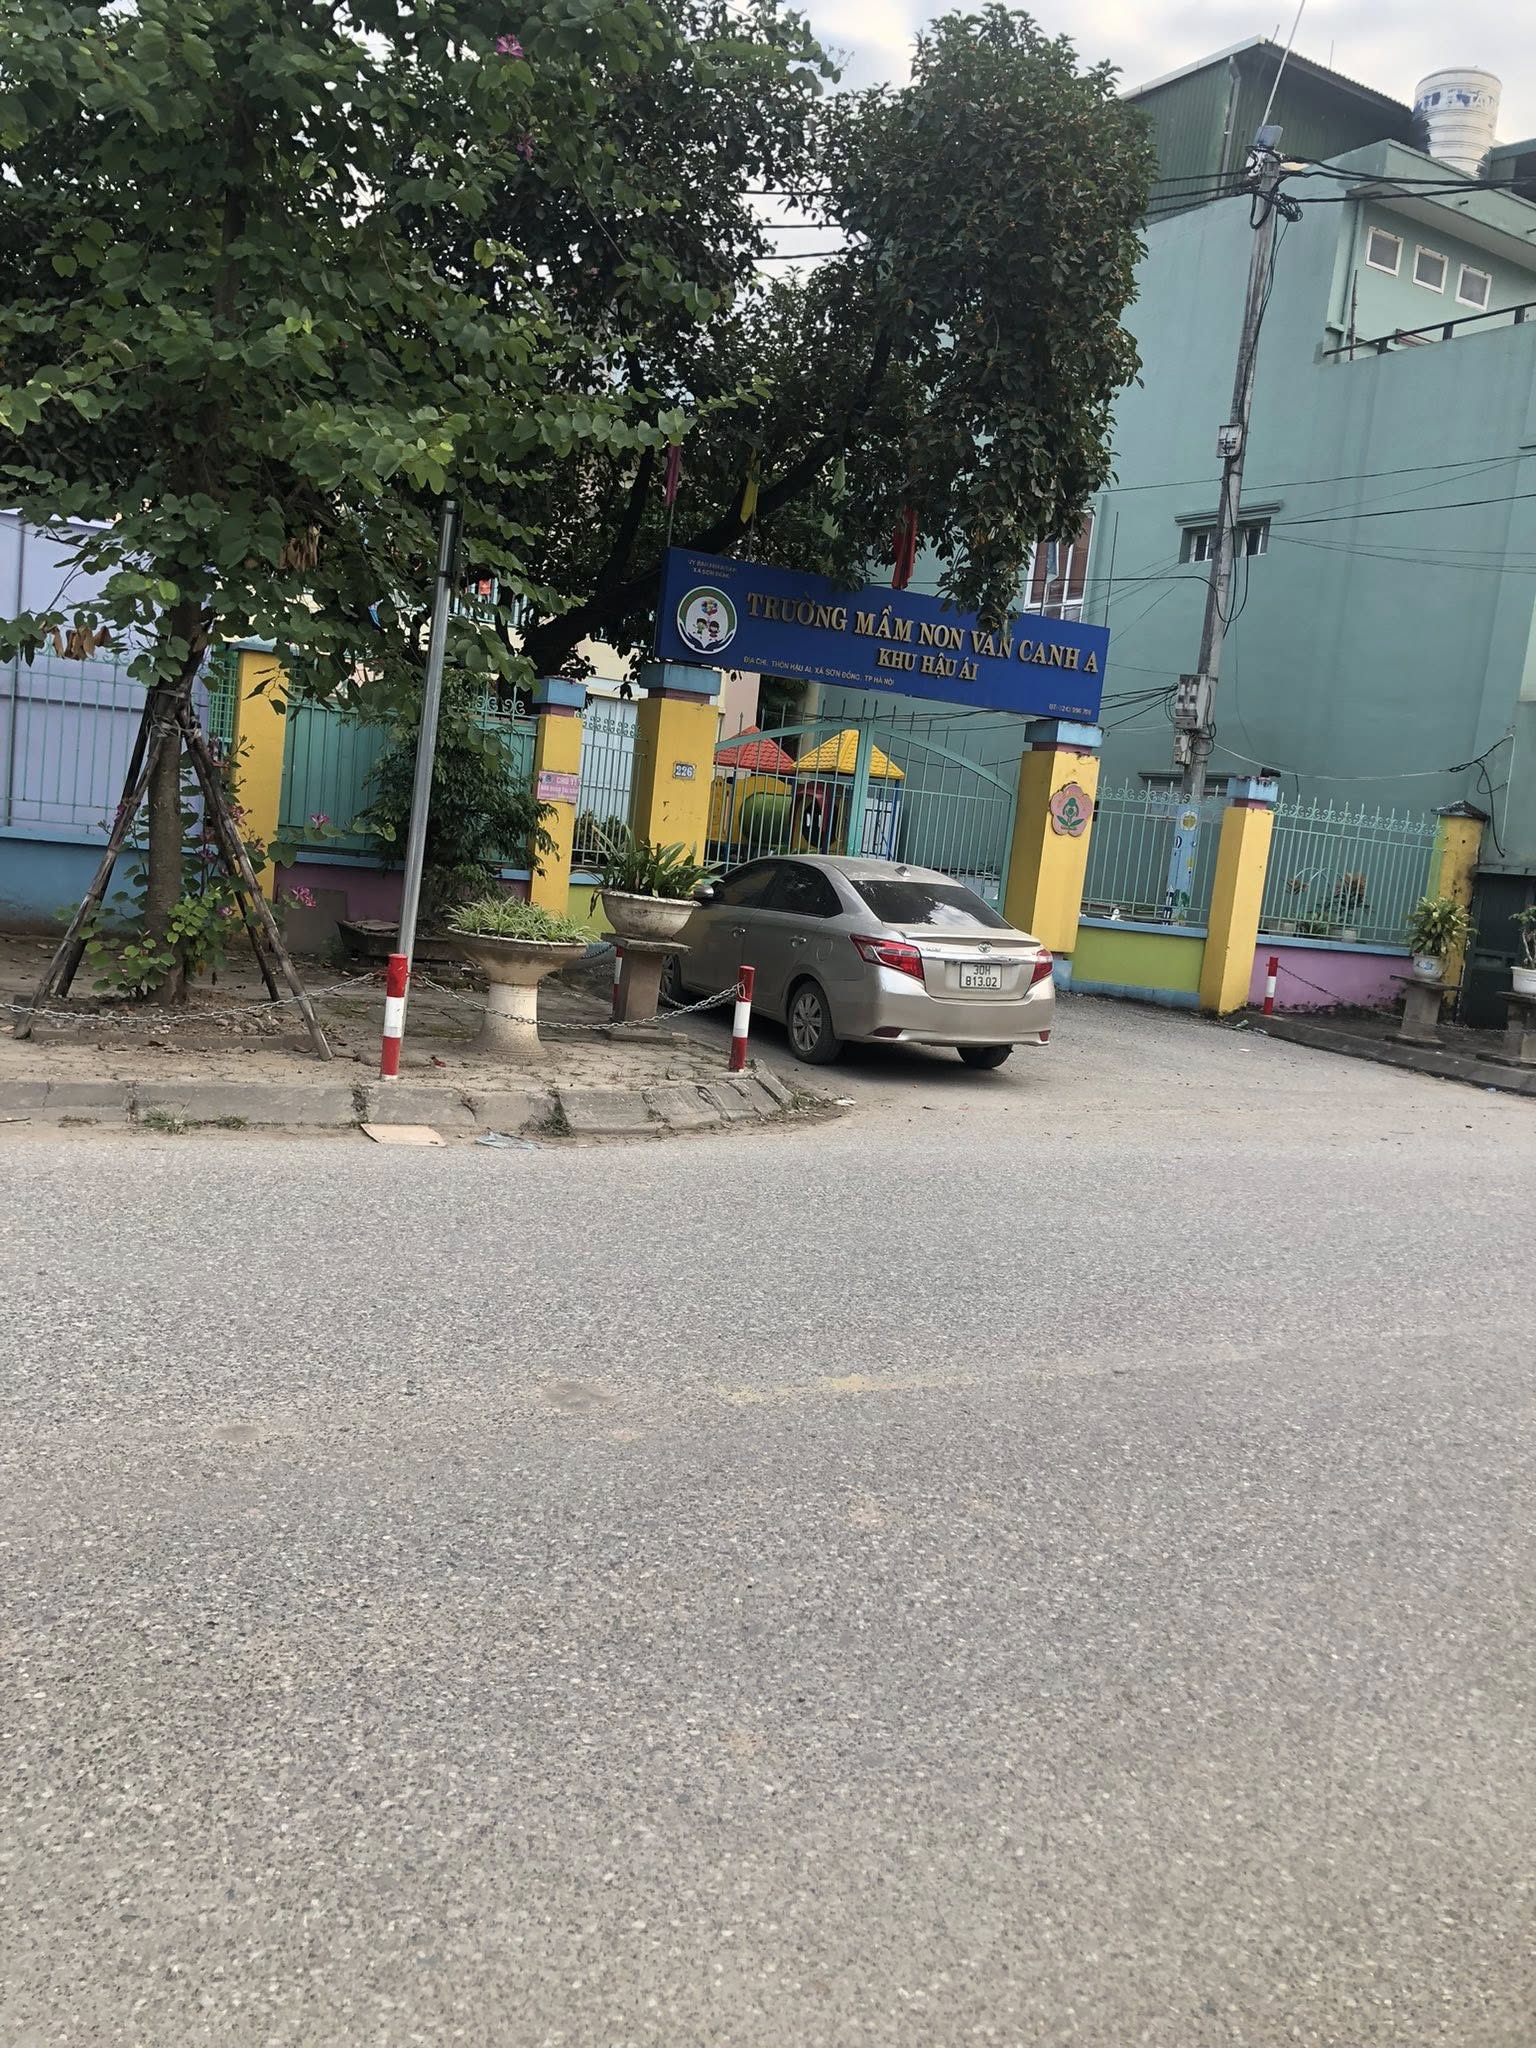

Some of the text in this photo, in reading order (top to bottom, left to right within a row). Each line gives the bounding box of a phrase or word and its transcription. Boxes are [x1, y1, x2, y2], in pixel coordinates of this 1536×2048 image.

[854, 604, 914, 643] MẦM
[918, 622, 966, 651] NON
[1019, 639, 1080, 671] CANH
[1083, 651, 1099, 673] A
[878, 647, 980, 681] KHU HẬU ÁI
[676, 764, 693, 777] 226
[973, 964, 991, 976] 30H
[965, 975, 997, 987] 813.02
